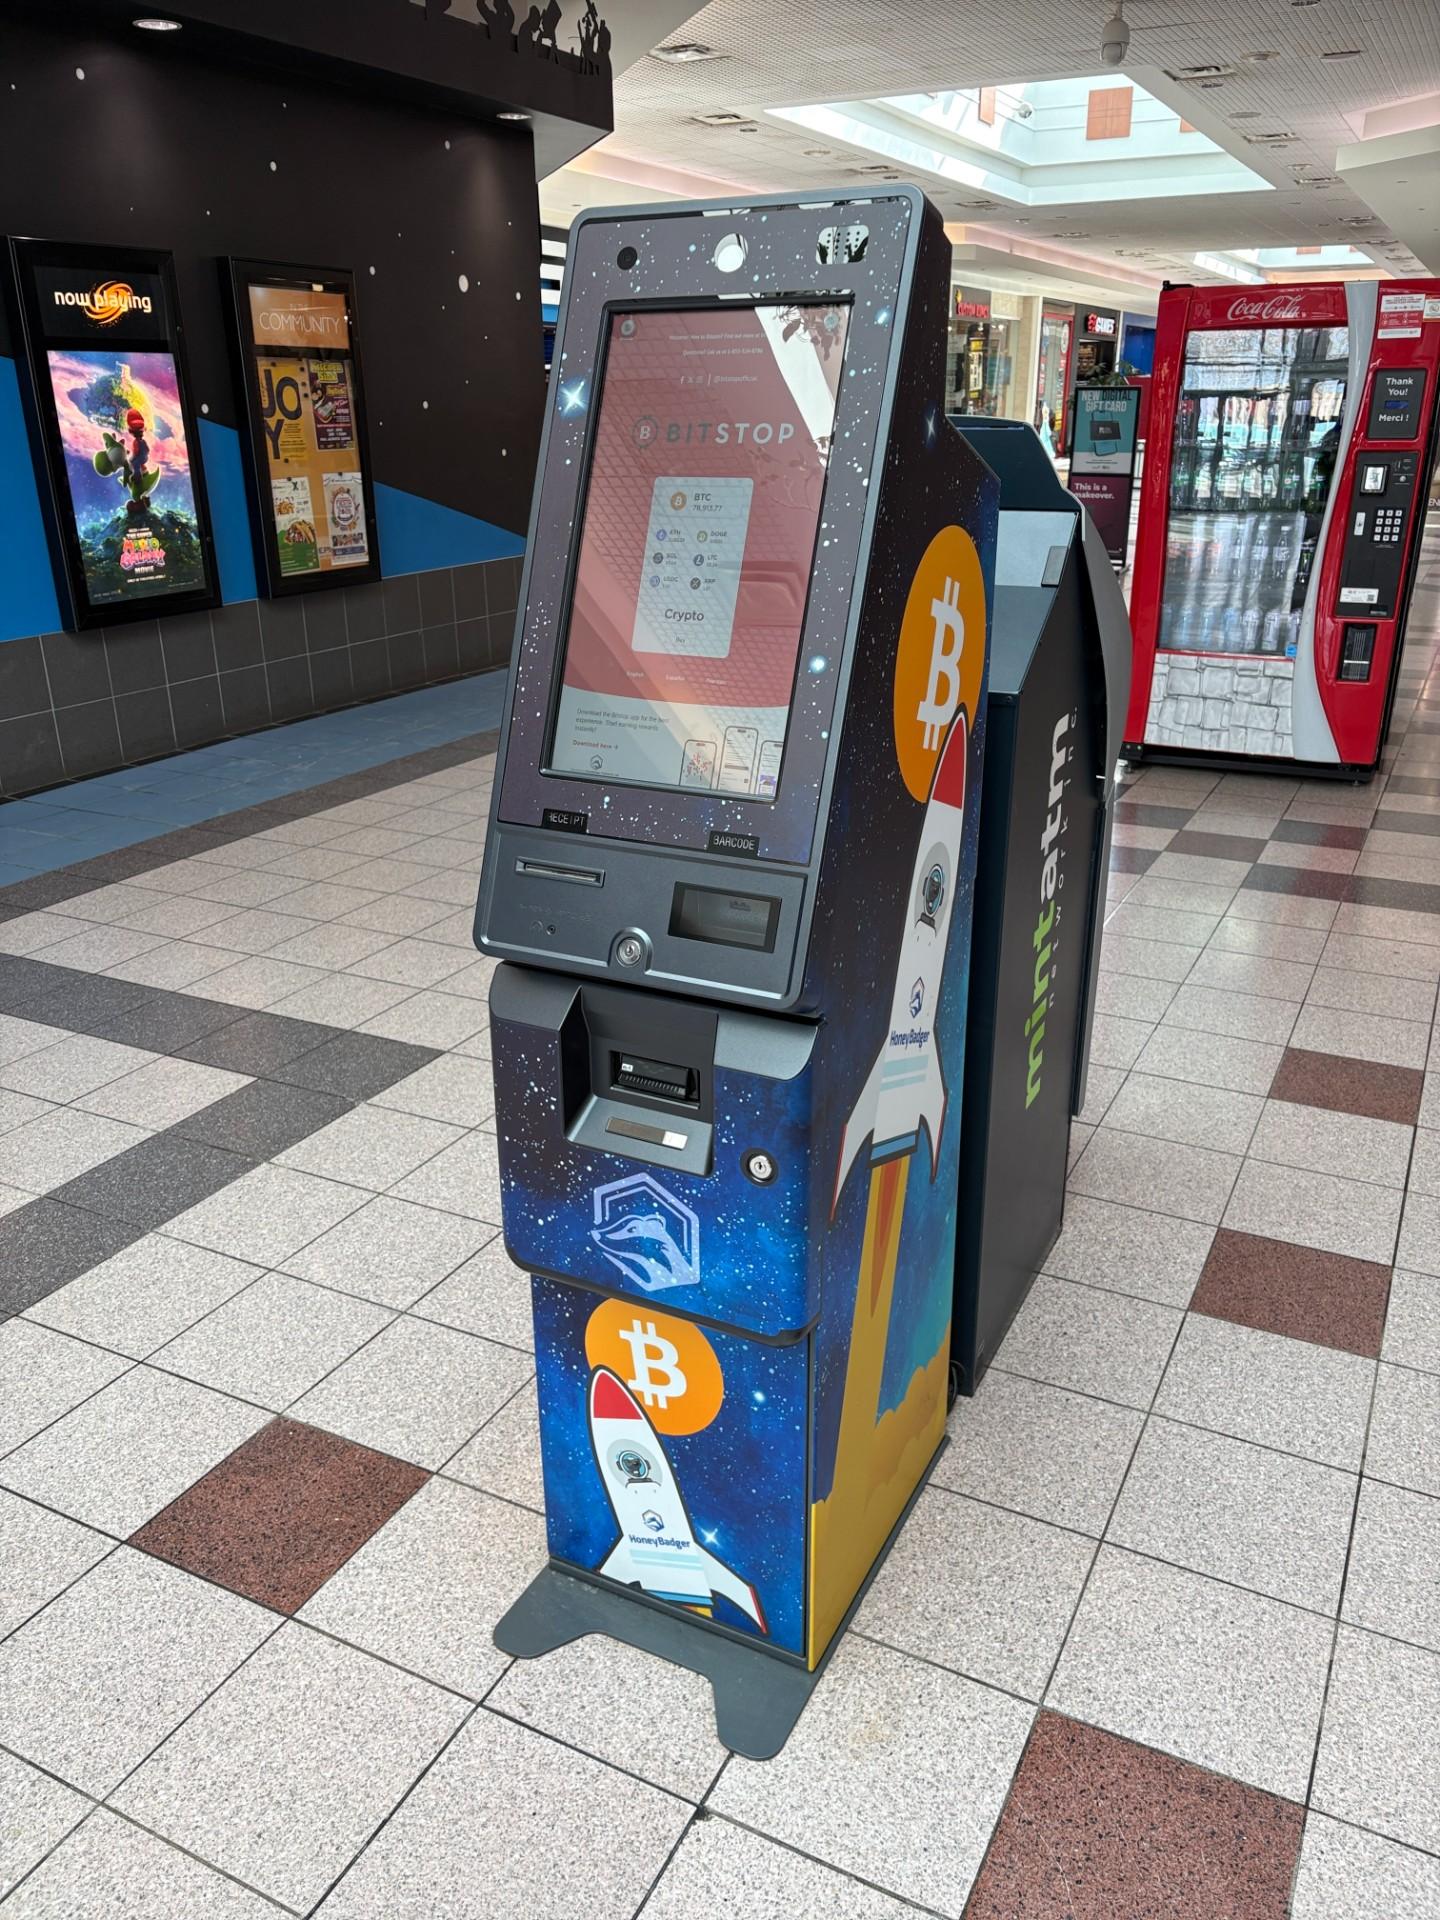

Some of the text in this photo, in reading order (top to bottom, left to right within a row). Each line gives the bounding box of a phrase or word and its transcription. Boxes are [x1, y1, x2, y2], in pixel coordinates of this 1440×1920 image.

[54, 290, 152, 313] now playing
[260, 312, 339, 334] COMMUNITY
[1386, 377, 1414, 385] Thank
[263, 369, 302, 420] JO
[1081, 390, 1132, 401] NEW DIGITAL
[1388, 388, 1408, 396] You!
[1086, 401, 1127, 412] GIFT CARD
[1378, 413, 1410, 422] Merci !
[264, 419, 285, 460] Y
[666, 422, 795, 445] BITSTOP
[1074, 483, 1092, 491] This
[1093, 483, 1100, 491] is
[1075, 491, 1115, 499] makeover.
[693, 493, 712, 501] BTC
[664, 608, 705, 622] Crypto
[713, 834, 756, 850] BARCODE
[1025, 712, 1069, 1109] mintatm
[1048, 817, 1068, 1008] network
[889, 1027, 930, 1050] HoneyBadger
[628, 1533, 691, 1550] HoneyBadger
